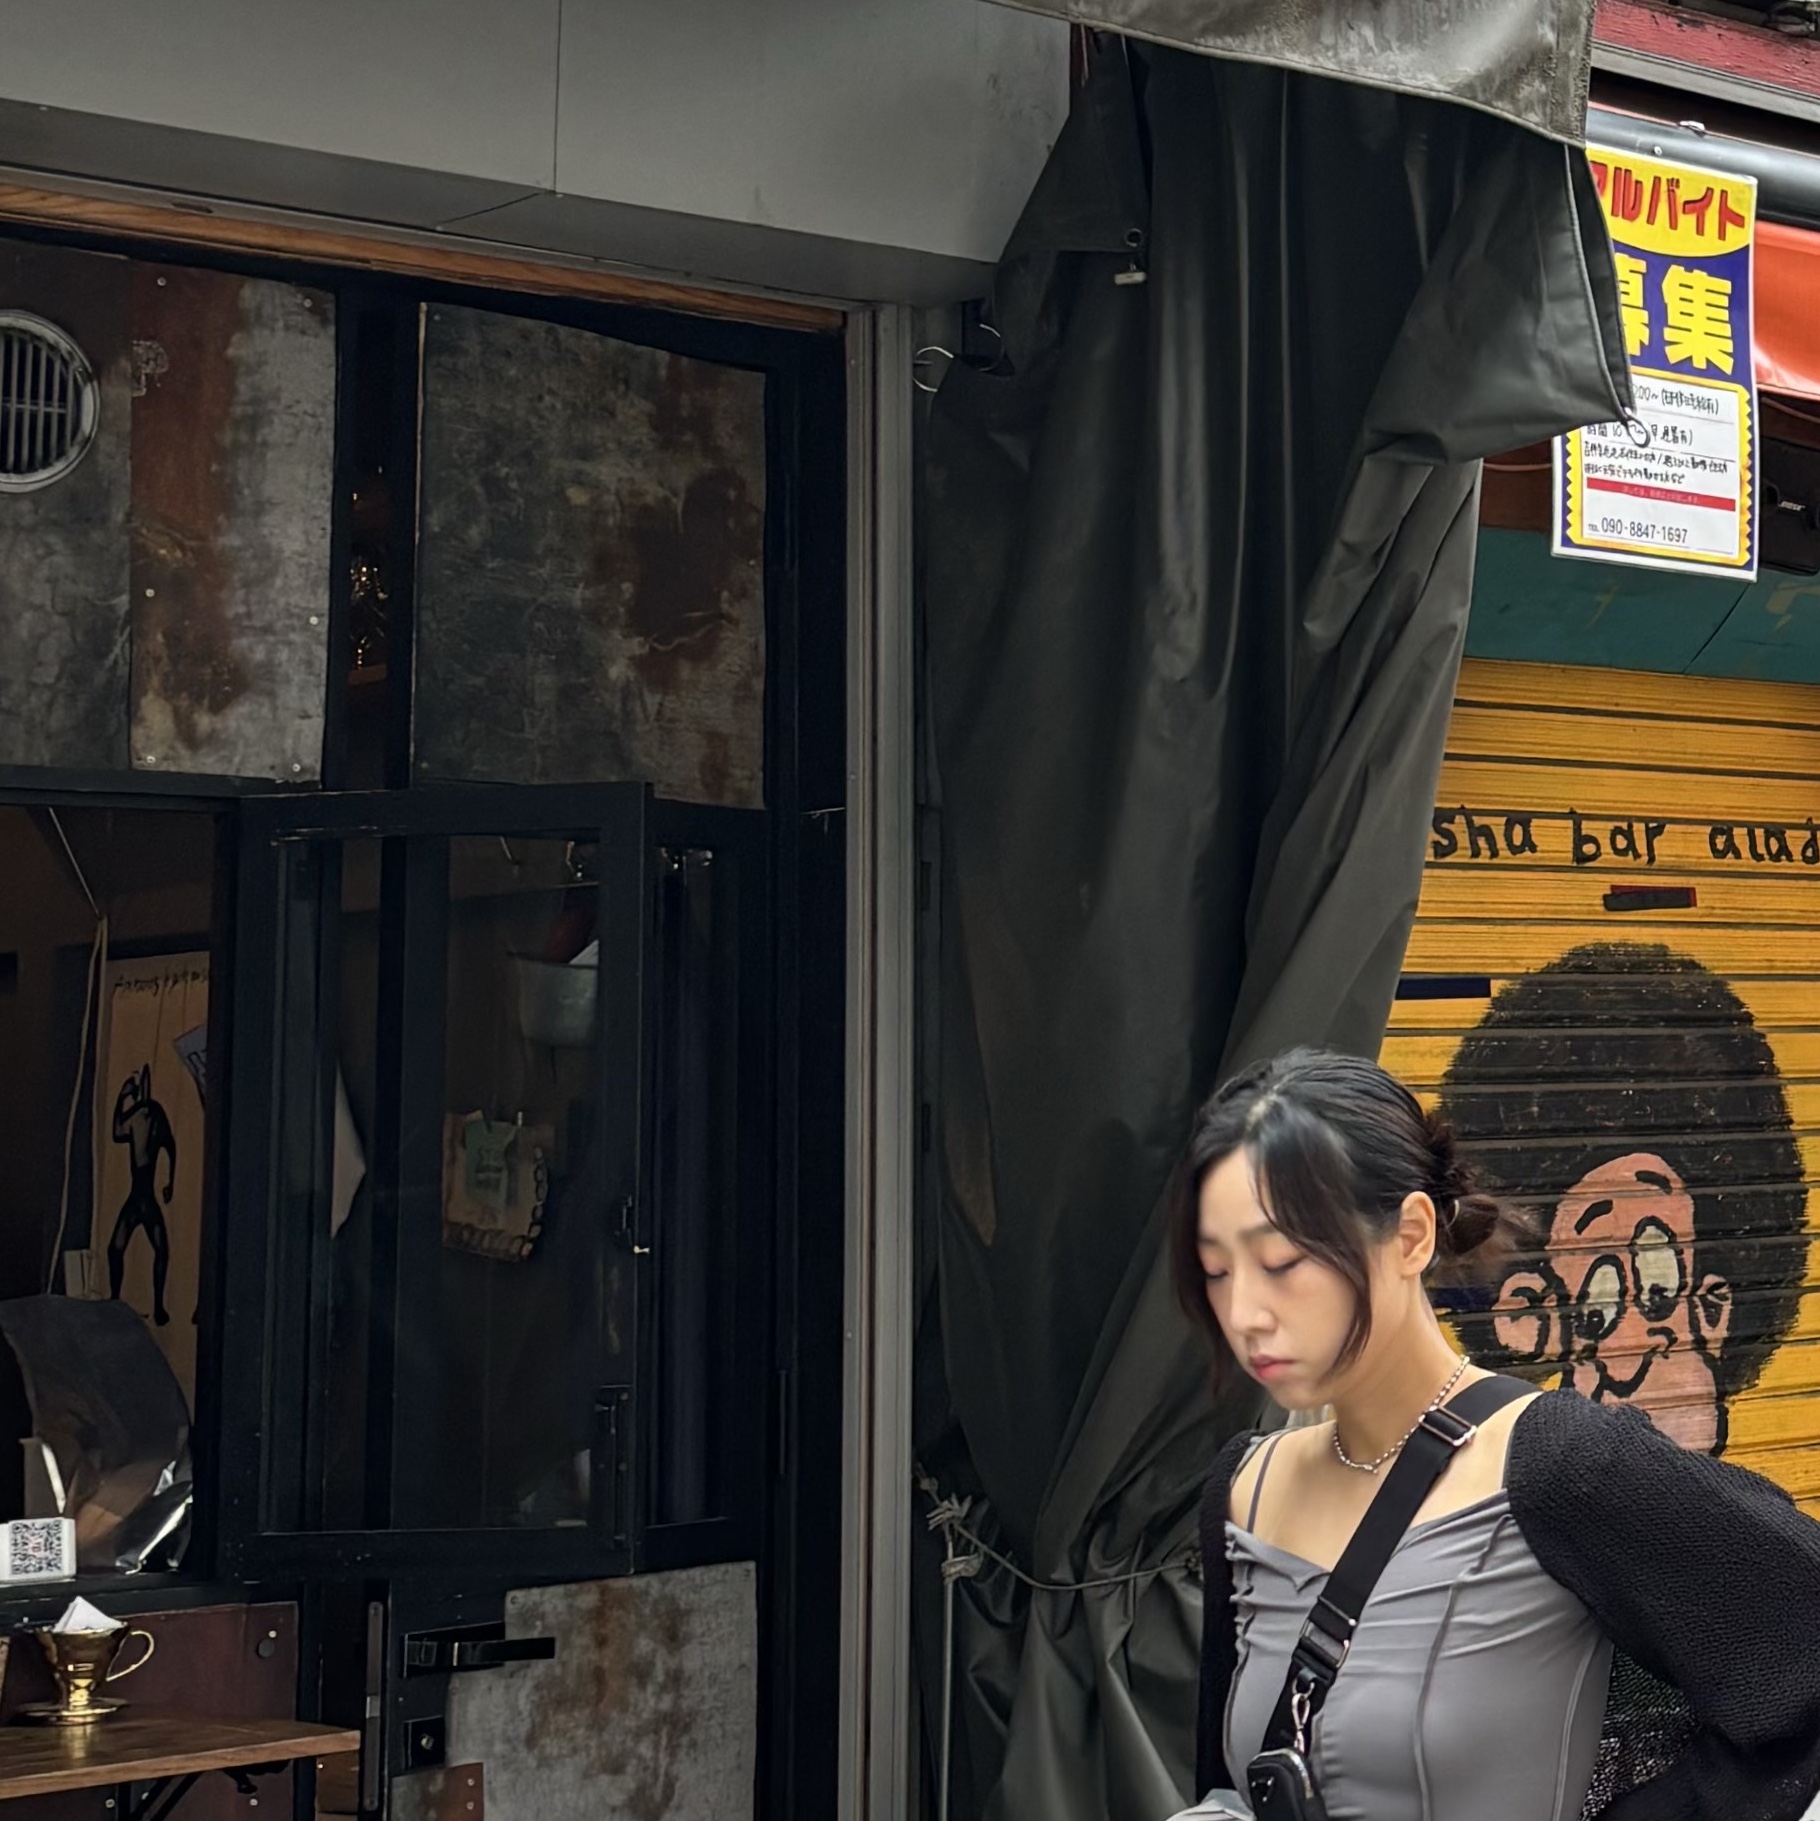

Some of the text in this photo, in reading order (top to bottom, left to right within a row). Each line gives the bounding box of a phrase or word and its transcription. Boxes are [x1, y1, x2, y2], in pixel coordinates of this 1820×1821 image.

[1601, 517, 1688, 543] 090-8847-1697
[1433, 805, 1537, 859] sha
[1571, 807, 1667, 866] bar
